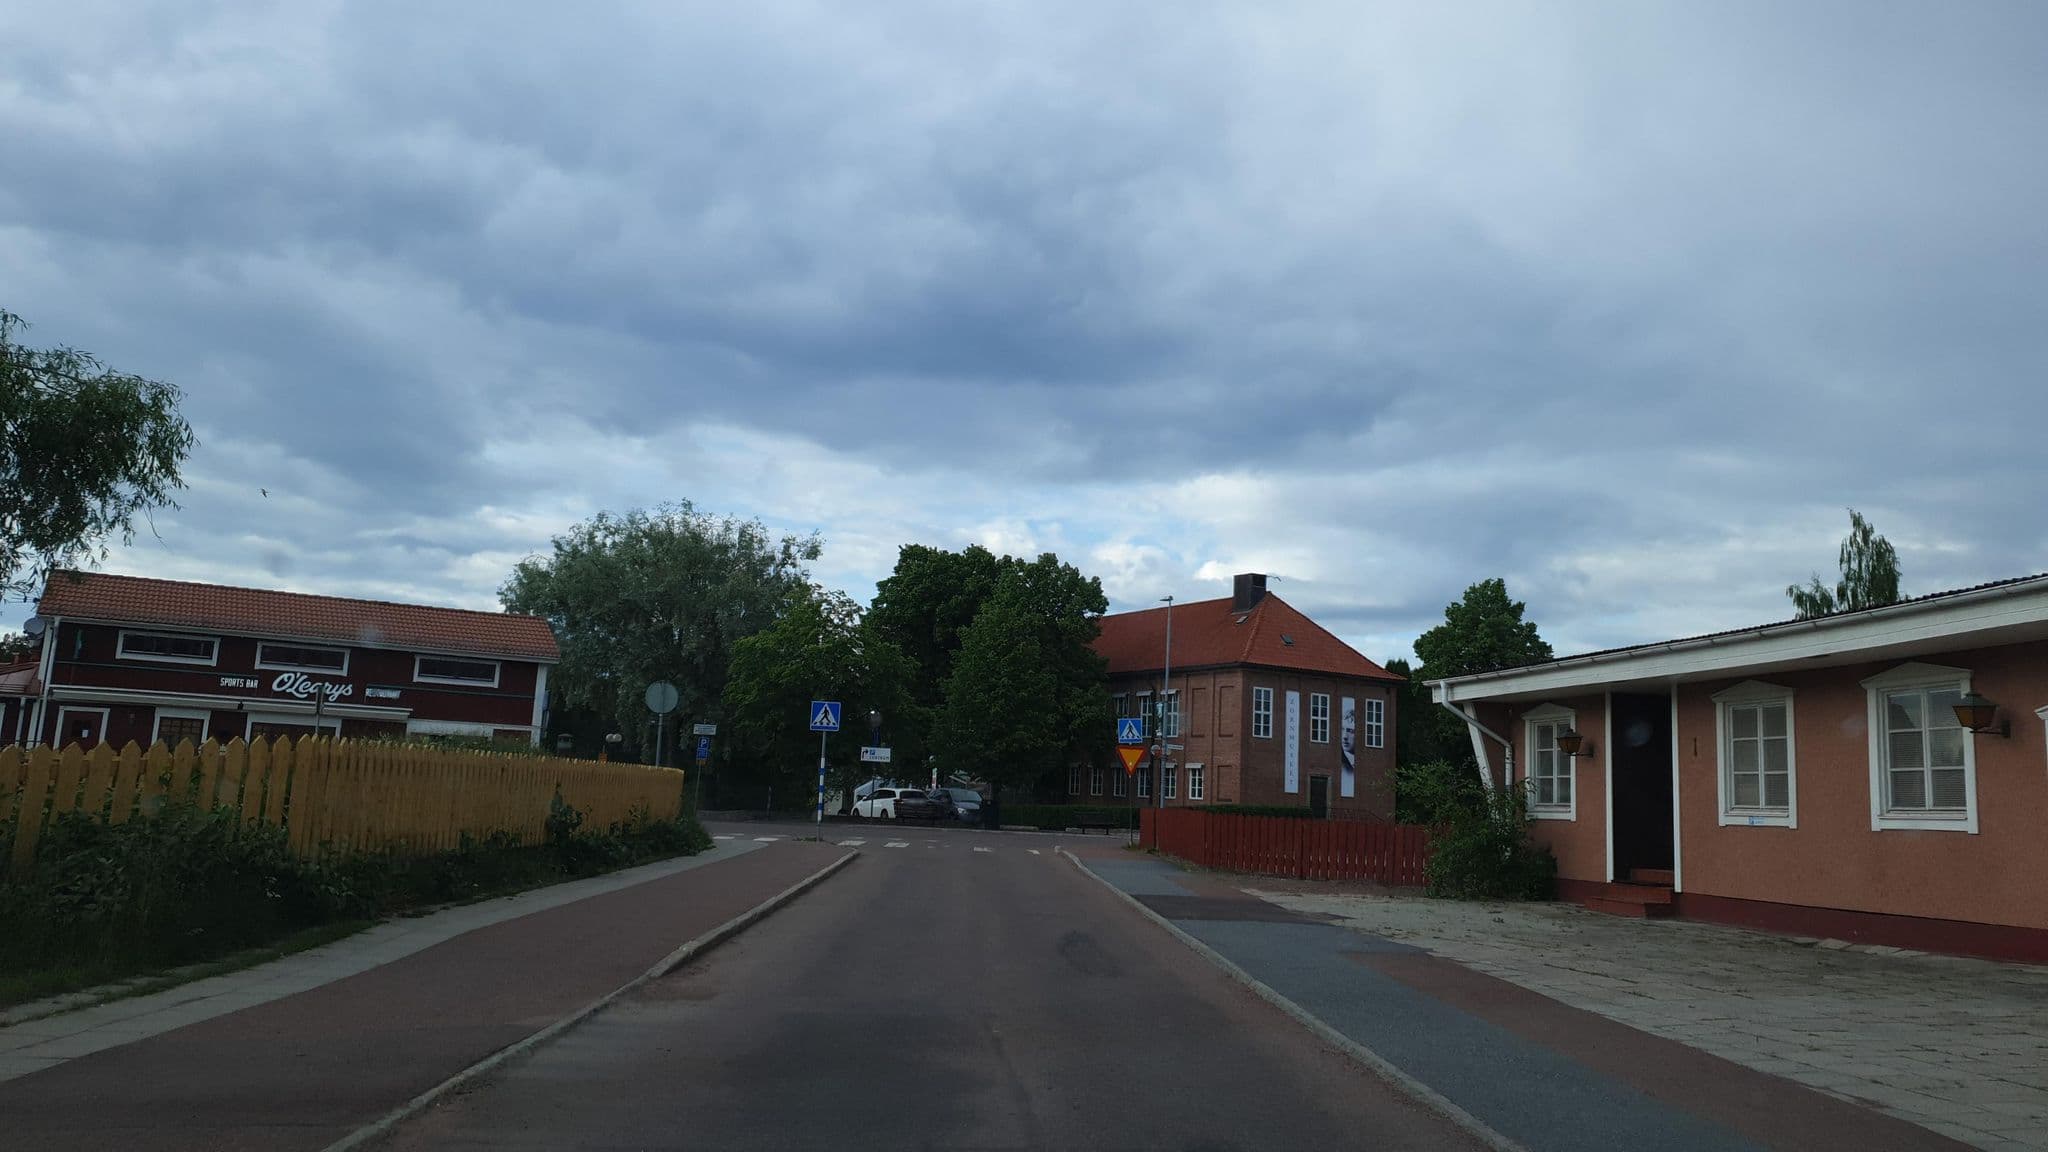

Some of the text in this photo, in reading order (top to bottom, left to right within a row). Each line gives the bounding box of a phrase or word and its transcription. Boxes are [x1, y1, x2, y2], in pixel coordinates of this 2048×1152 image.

[220, 677, 259, 689] SPORTS BAR
[272, 672, 353, 702] O'Learys
